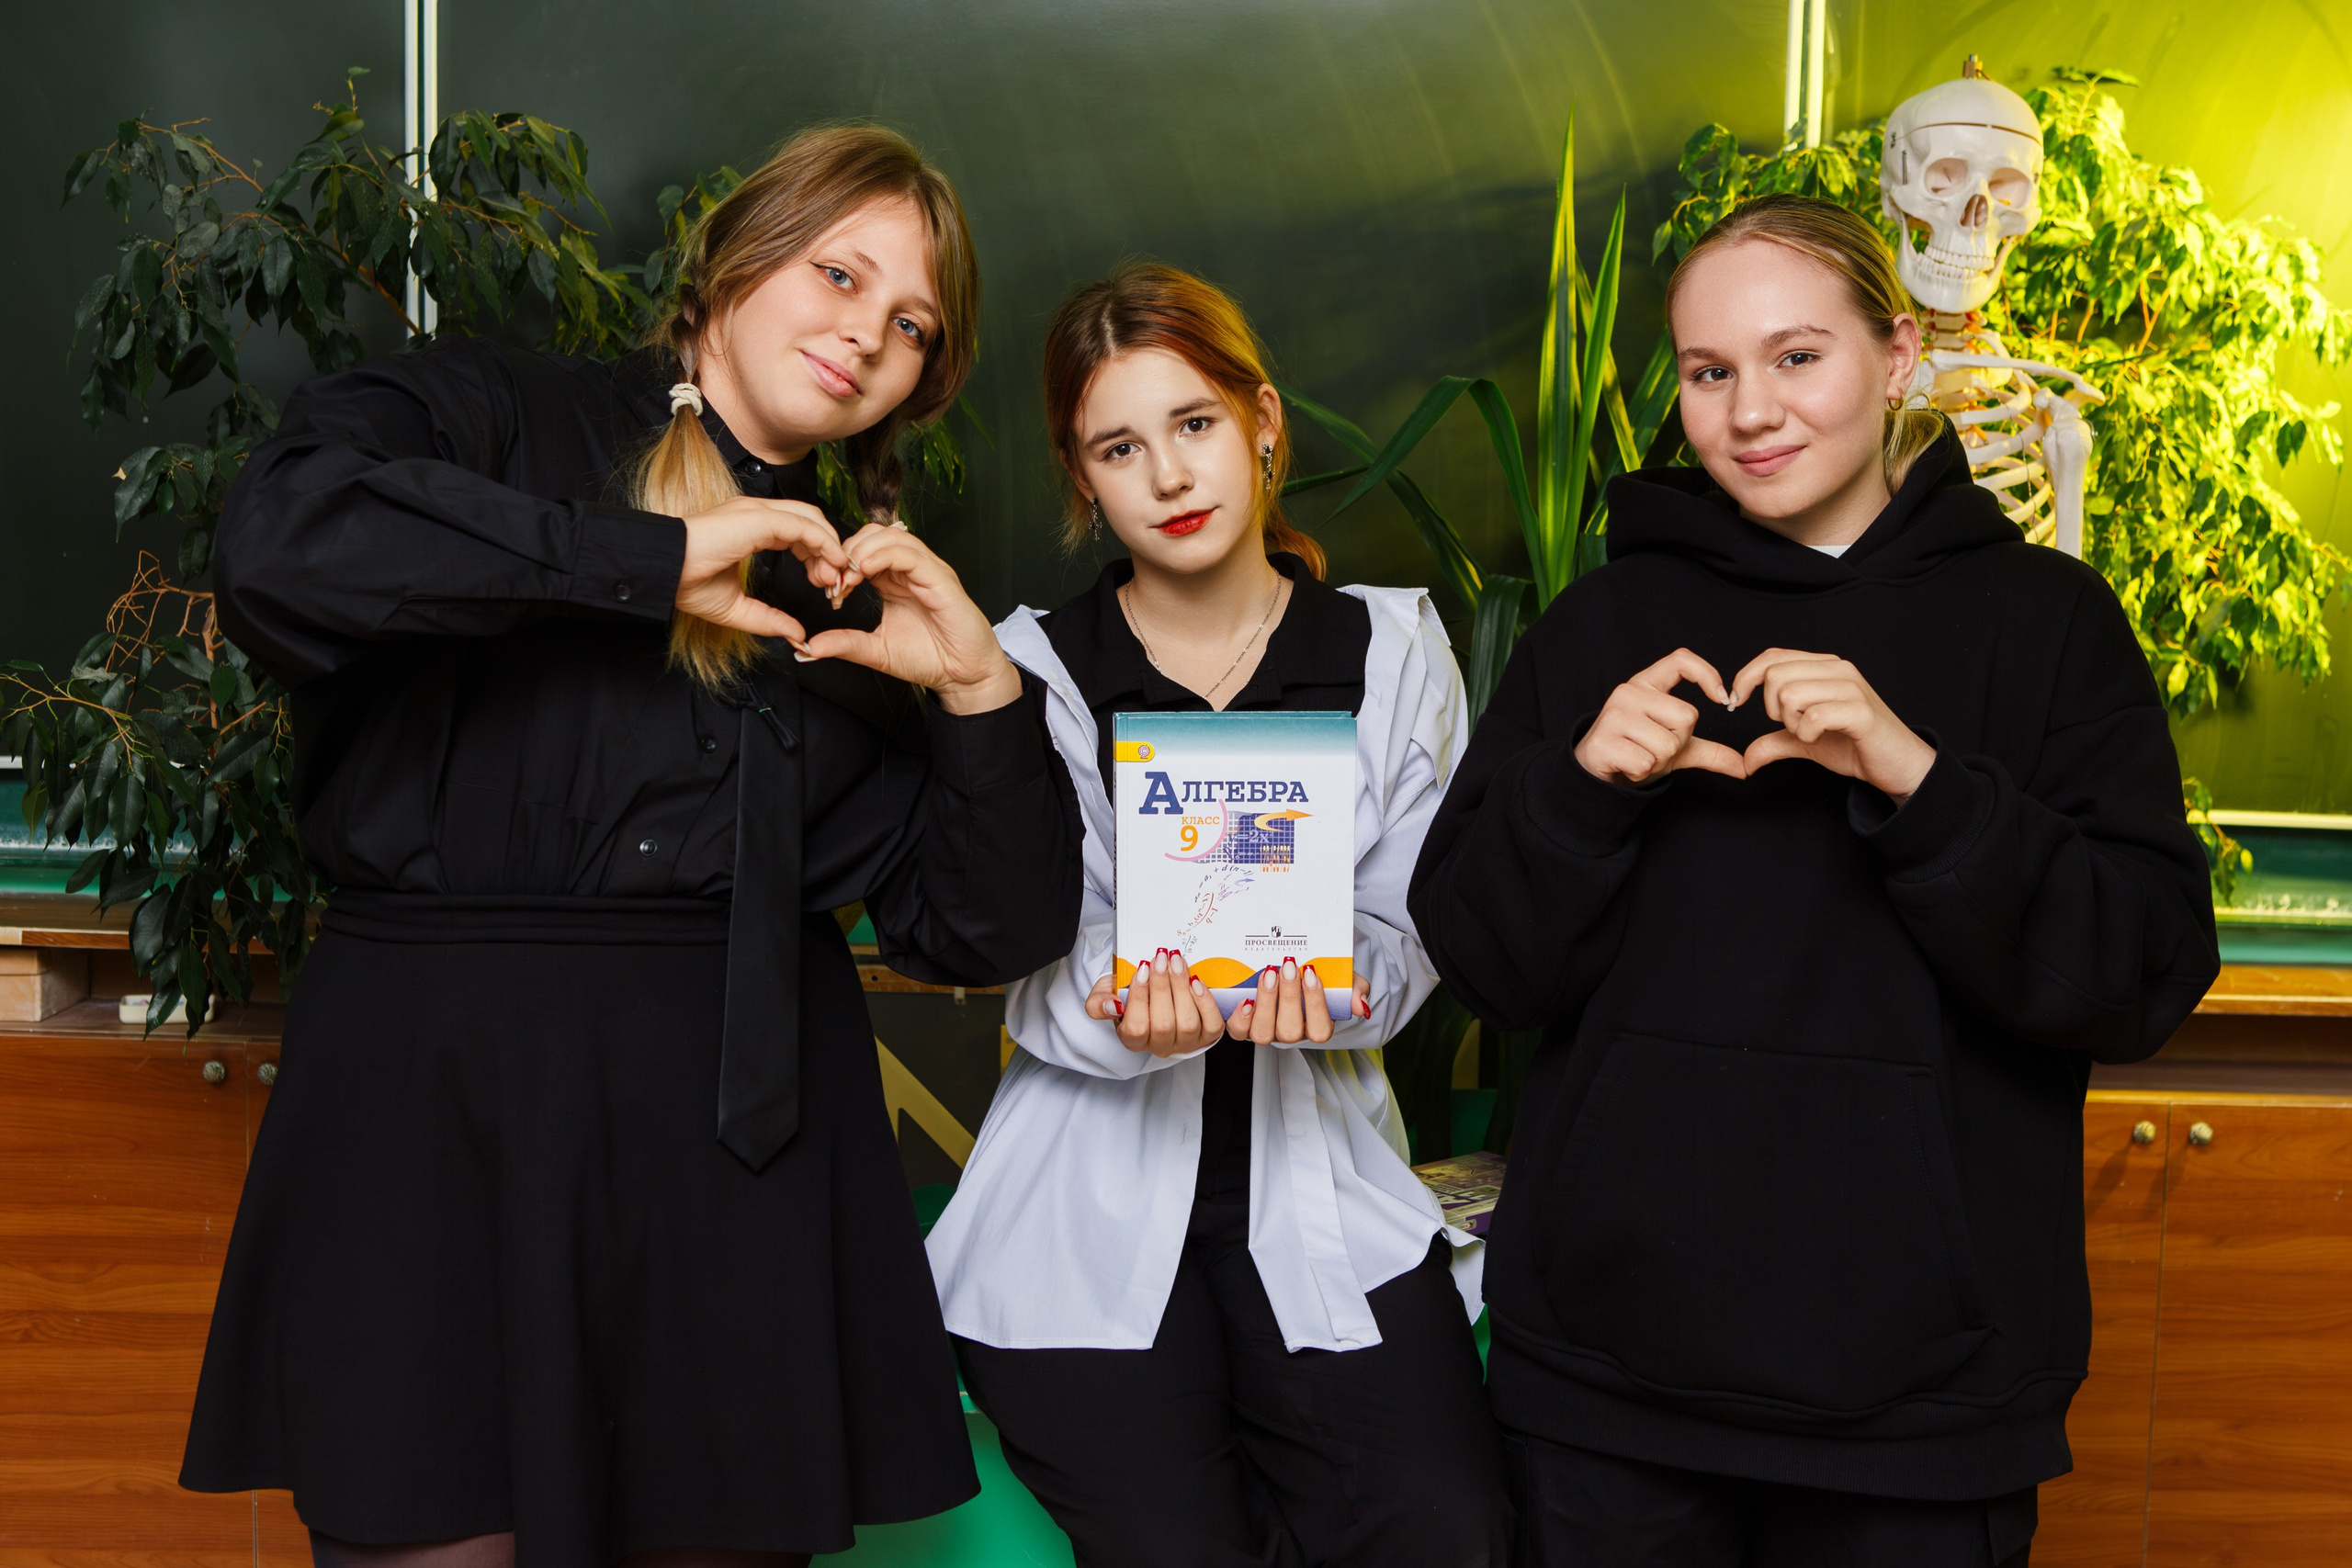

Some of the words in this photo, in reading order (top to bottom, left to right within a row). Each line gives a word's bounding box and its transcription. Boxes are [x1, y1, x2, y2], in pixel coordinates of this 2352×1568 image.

[1138, 772, 1309, 815] АЛГЕБРА
[1181, 817, 1220, 825] КЛАСС
[1180, 825, 1199, 852] 9
